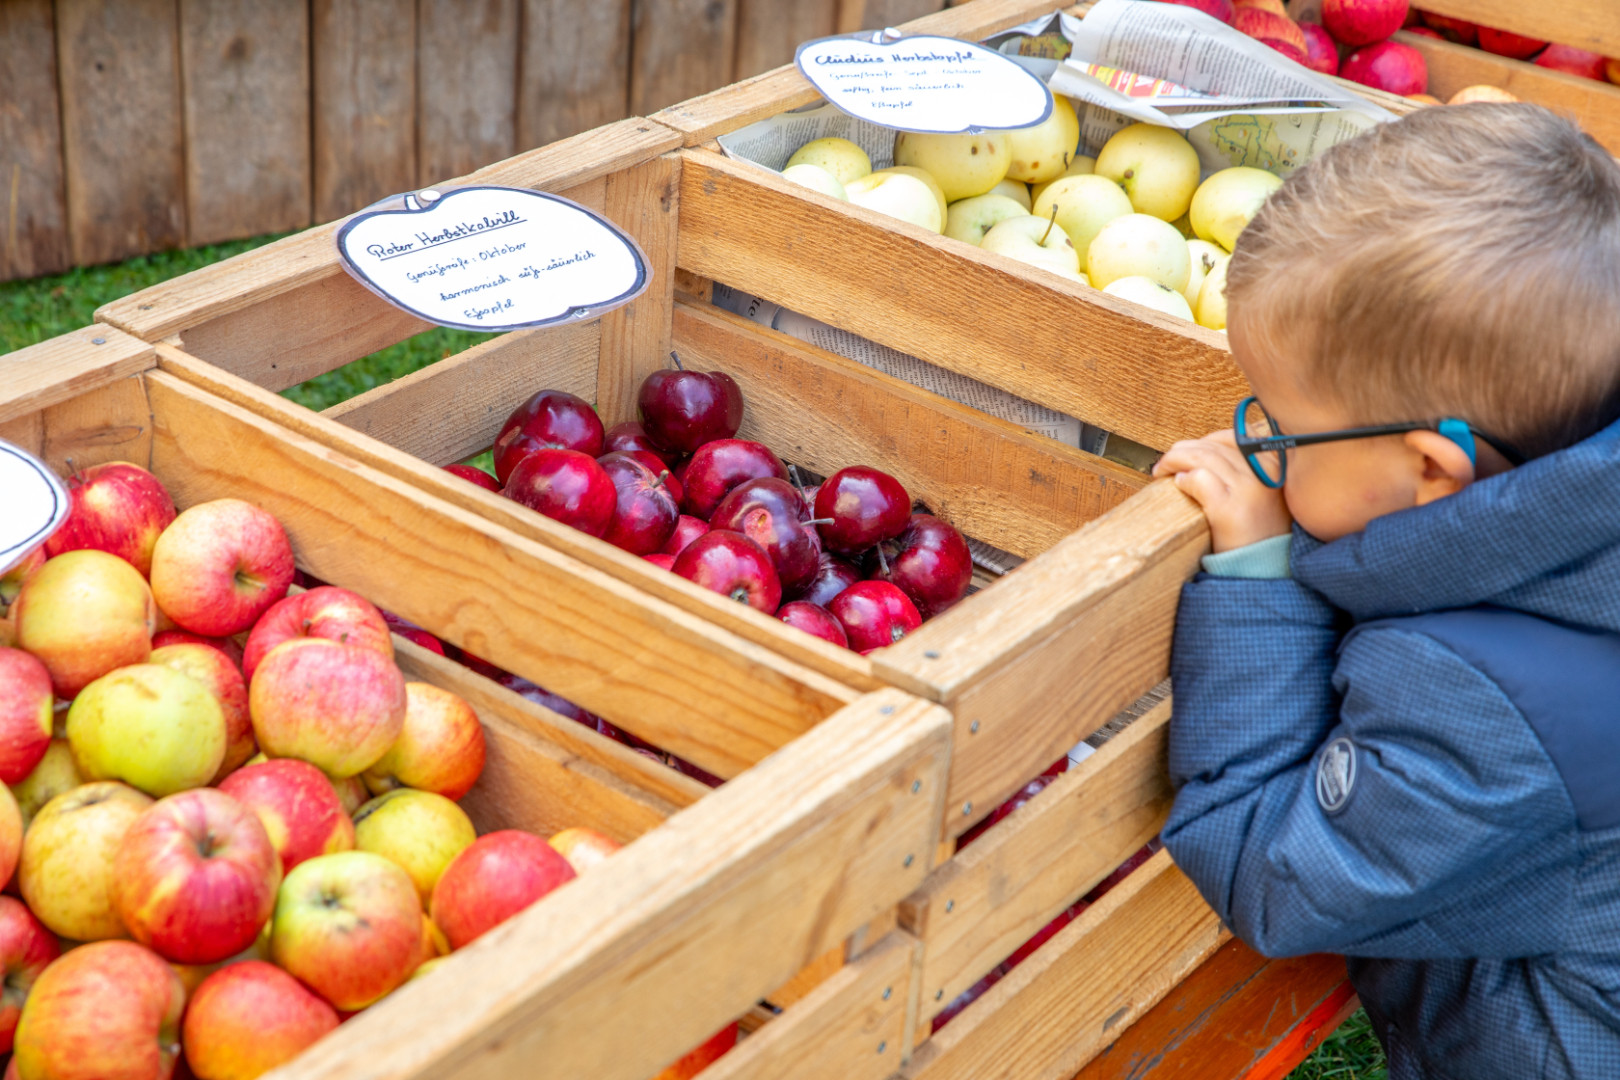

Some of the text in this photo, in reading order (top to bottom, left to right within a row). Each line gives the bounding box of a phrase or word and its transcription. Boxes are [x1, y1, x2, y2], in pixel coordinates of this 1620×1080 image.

[892, 50, 975, 64] Herbstapfel
[367, 210, 520, 260] Roter Herbstkalvill
[479, 242, 526, 262] Oktober
[440, 274, 511, 302] harmonisch
